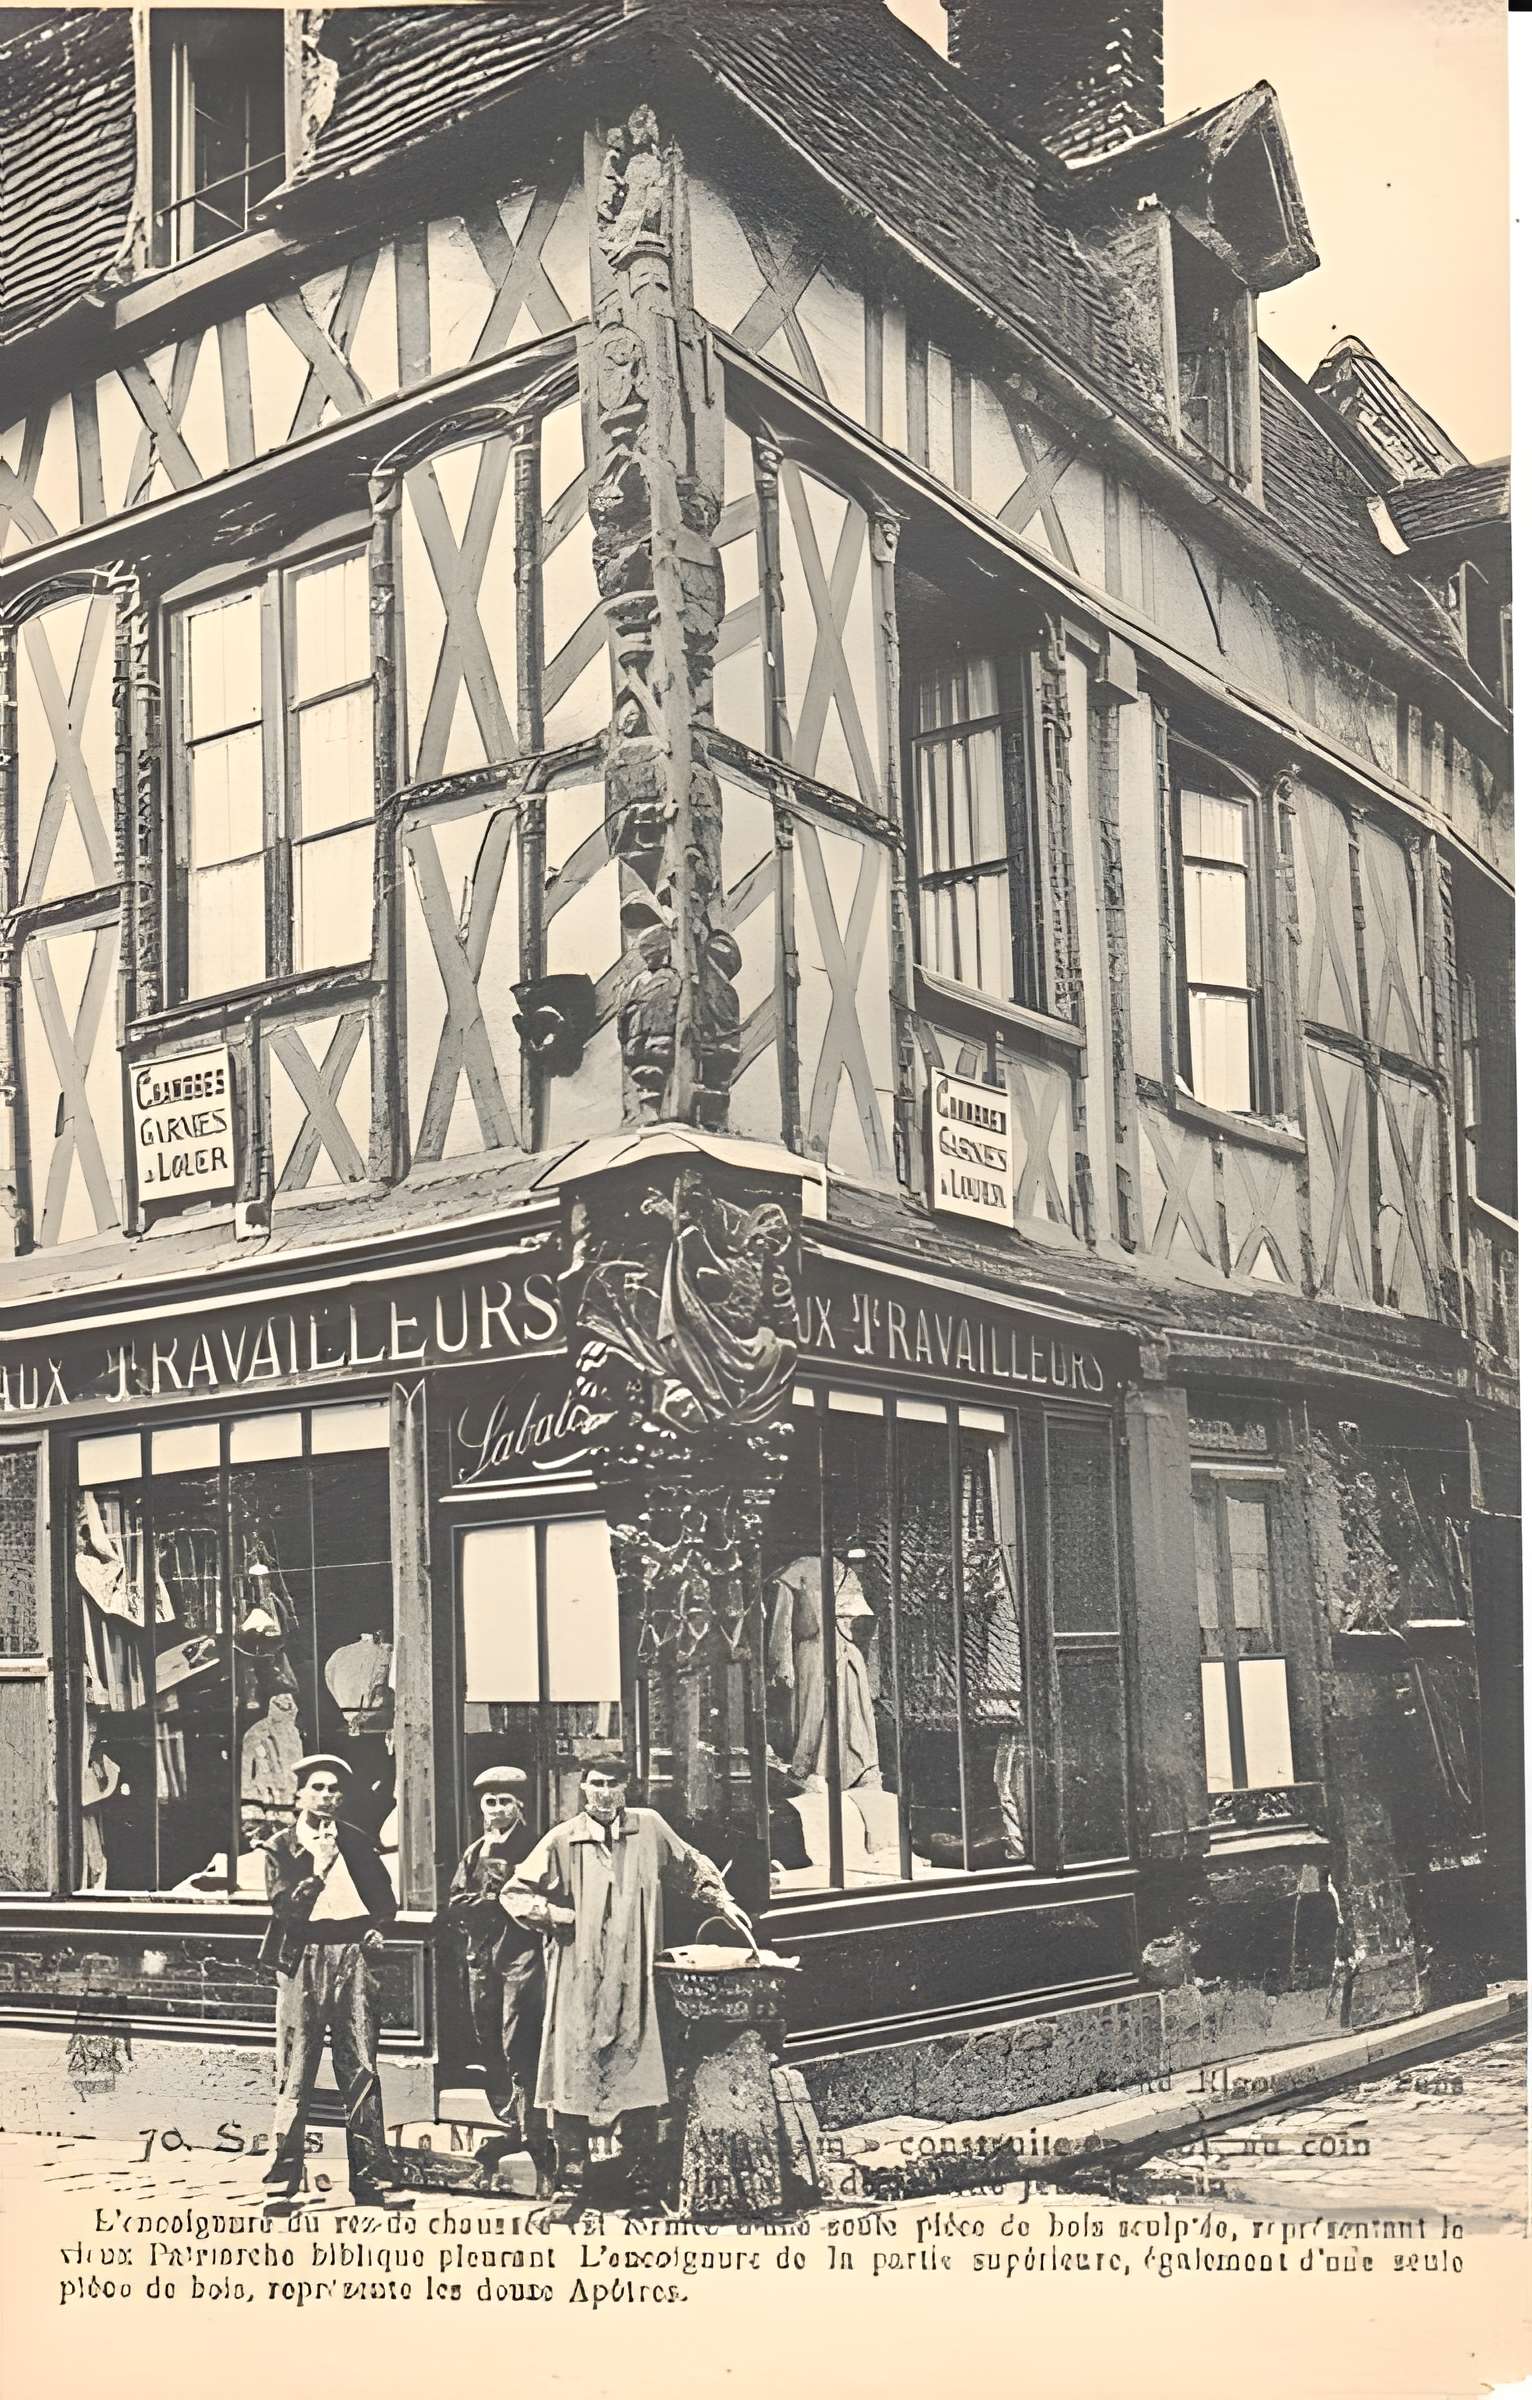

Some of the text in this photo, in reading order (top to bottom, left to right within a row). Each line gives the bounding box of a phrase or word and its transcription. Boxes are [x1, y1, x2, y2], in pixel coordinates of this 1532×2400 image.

[104, 1274, 560, 1404] TRAVAILLEURS
[795, 1292, 1104, 1392] UX TRAVAILLEURS
